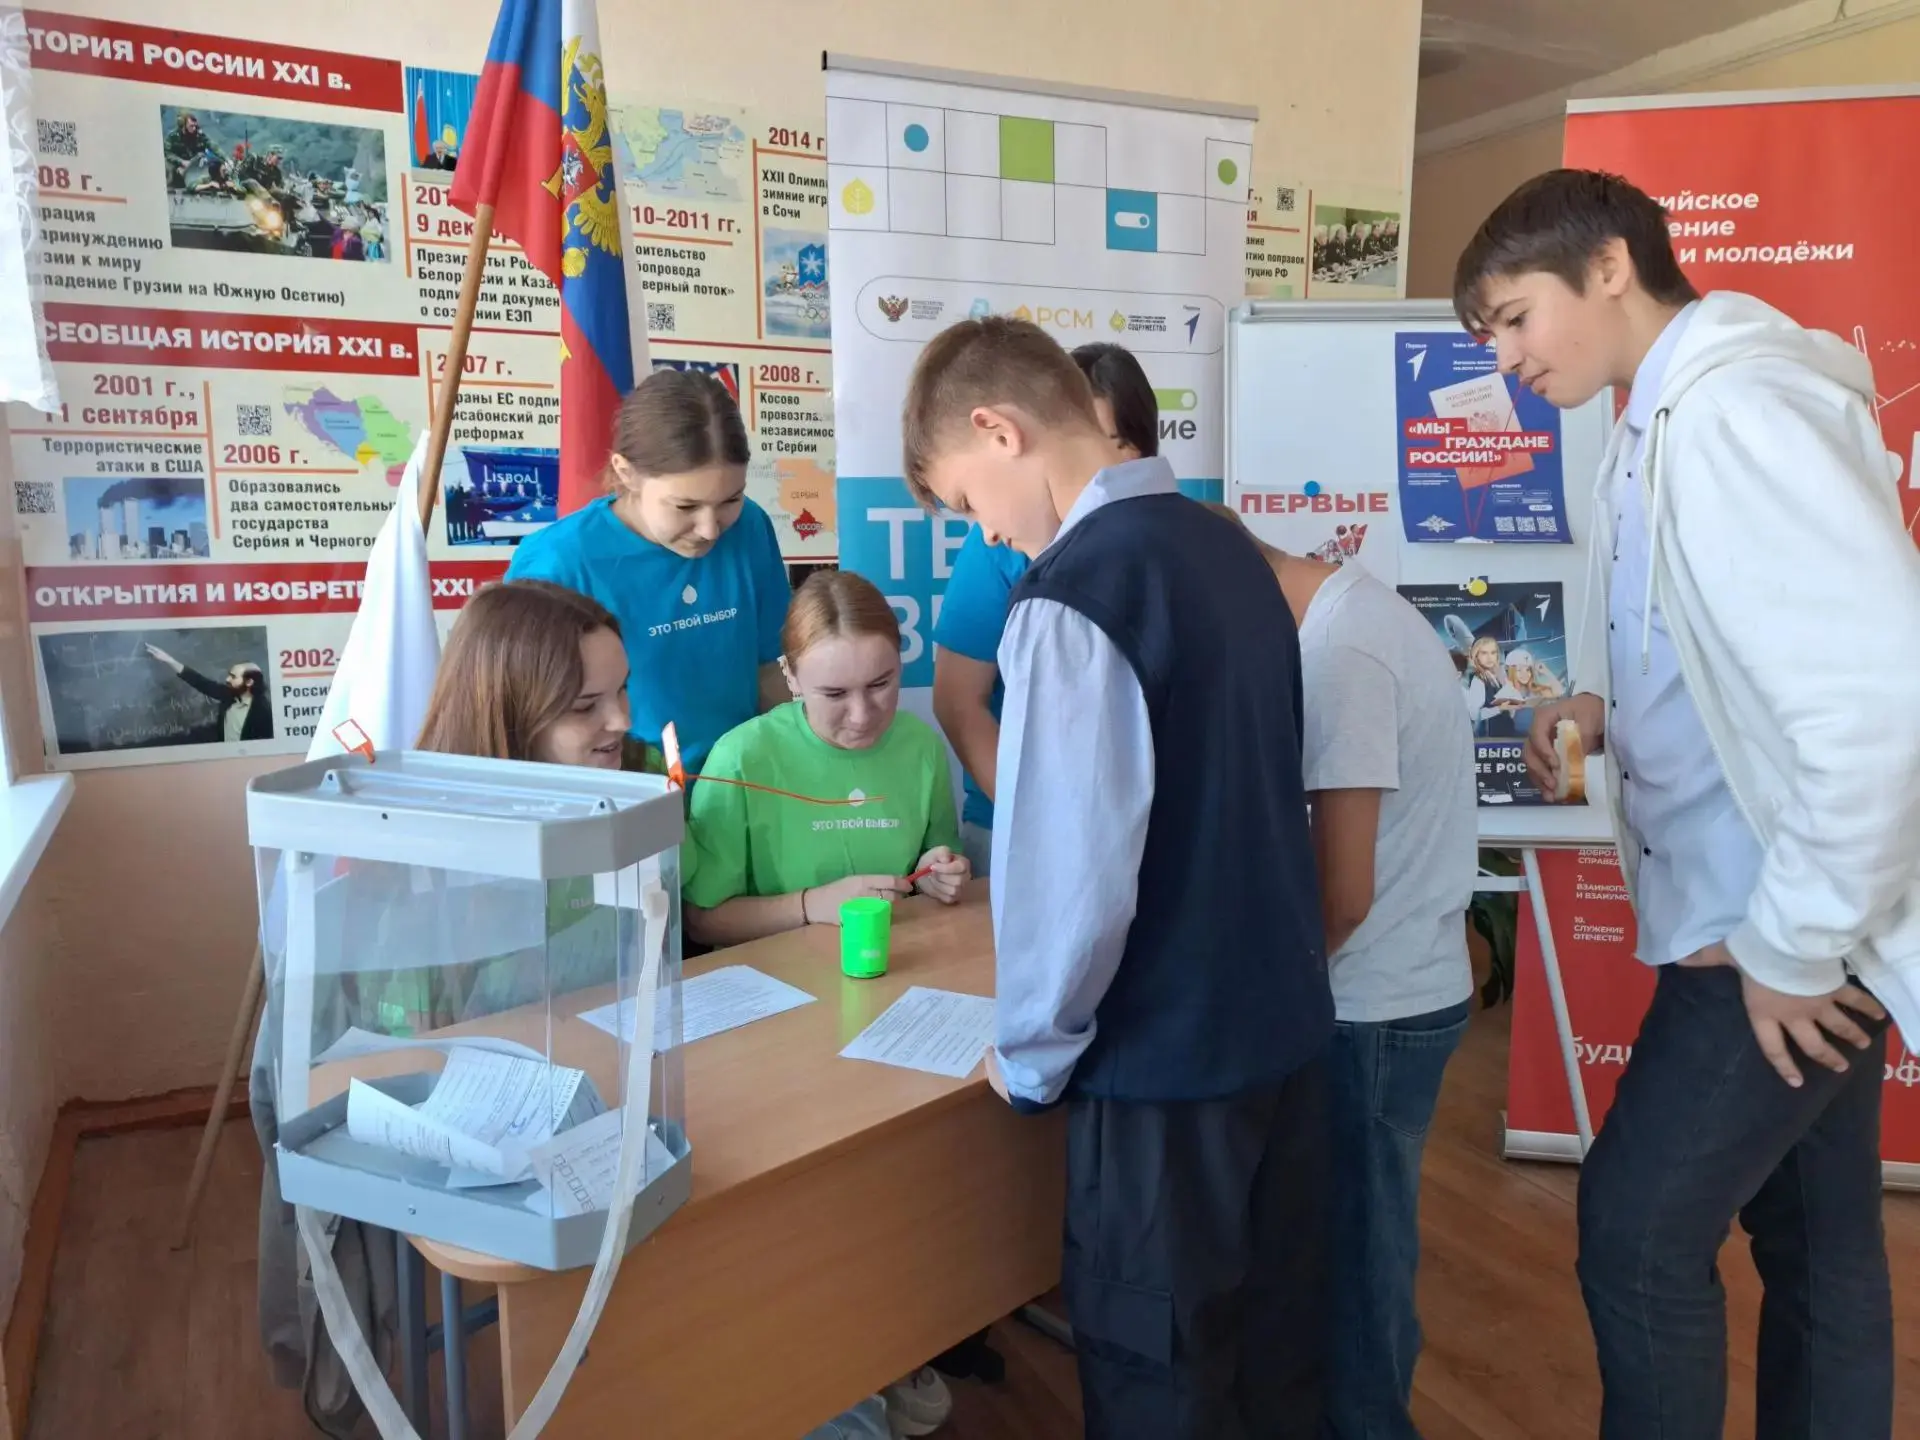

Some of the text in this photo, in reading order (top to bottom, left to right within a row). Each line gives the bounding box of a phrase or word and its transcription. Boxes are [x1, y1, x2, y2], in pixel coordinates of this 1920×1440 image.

[28, 27, 352, 90] ТОРИЯ РОССИИ XXI в.
[768, 127, 810, 149] 2014
[38, 165, 102, 192] 08 г.
[788, 172, 828, 188] Олимп
[762, 189, 828, 208] зимние игр
[1656, 190, 1760, 211] ийское
[763, 204, 801, 219] в Сочи
[417, 214, 429, 232] 9
[718, 217, 741, 234] гг.
[1668, 220, 1736, 237] ение
[635, 245, 706, 261] оительство
[1679, 240, 1854, 265] и молодёжи
[82, 254, 91, 266] к
[98, 256, 141, 272] миру
[1246, 267, 1289, 278] туцию РФ
[508, 276, 517, 286] и
[521, 275, 559, 289] Каза
[642, 280, 735, 297] верный поток»
[123, 276, 183, 297] Грузии
[188, 284, 208, 297] на
[214, 283, 276, 302] Южную
[281, 287, 345, 306] Осетию)
[420, 306, 532, 323] о сознии ЕЭП
[201, 329, 330, 355] ИСТОРИЯ
[338, 337, 382, 357] XXI
[390, 344, 412, 359] в.
[437, 353, 513, 375] 207 г.
[760, 364, 820, 384] 2008 г.
[93, 374, 195, 400] 2001 г.,
[497, 392, 514, 405] ЕС
[519, 396, 559, 408] подпи
[760, 392, 800, 405] Косово
[82, 404, 198, 430] сентября
[538, 413, 561, 425] дог
[760, 410, 822, 422] провозгла
[454, 426, 525, 442] реформах
[760, 426, 834, 438] независимос
[1159, 419, 1197, 440] ие
[1408, 422, 1450, 435] «МЫ
[42, 437, 203, 456] Террористические
[761, 440, 818, 454] от Сербии
[1445, 436, 1550, 450] ГРАЖДАНЕ
[223, 444, 308, 465] 2006 г.
[1409, 450, 1502, 464] РОССИИ!»
[96, 459, 204, 474] атаки в США
[228, 479, 341, 496] Образовались
[230, 500, 396, 513] два самостоятельны
[1240, 493, 1389, 514] ПЕРВЫЕ
[231, 518, 329, 532] государства
[232, 534, 290, 551] Сербия
[295, 536, 305, 548] и
[36, 582, 198, 608] ОТКРЫТИЯ
[206, 582, 225, 605] И
[648, 608, 738, 637] ЭТО ТВОЙ ВЫБОР
[282, 685, 331, 698] Росси
[1478, 747, 1522, 758] ВЫБО
[1496, 762, 1527, 774] РОС
[812, 816, 900, 831] ЭТО ТВОЙ ВЫБОР
[1573, 933, 1625, 942] ОТЕЧЕСТВУ
[1574, 925, 1625, 934] СЛУЖЕНИЕ
